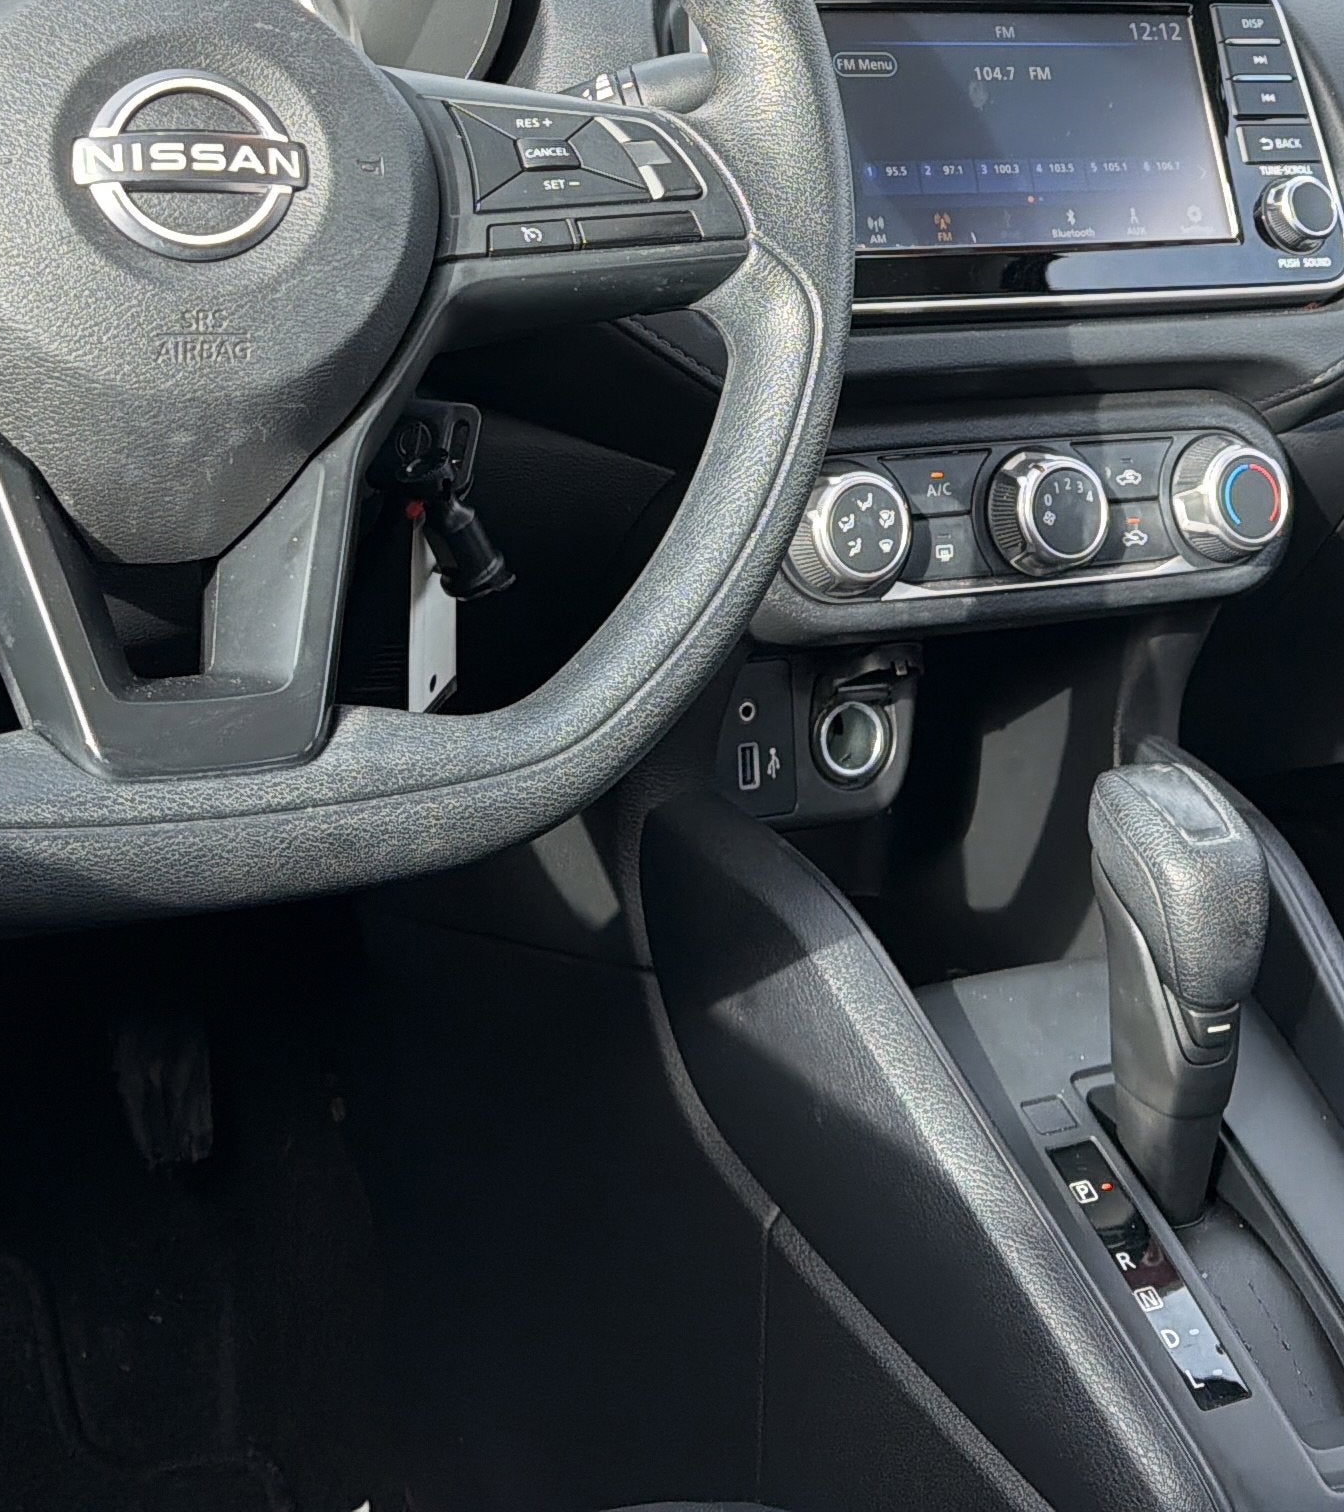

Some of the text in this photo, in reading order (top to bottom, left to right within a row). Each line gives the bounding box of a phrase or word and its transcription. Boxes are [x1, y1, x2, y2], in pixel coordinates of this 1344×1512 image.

[1241, 18, 1264, 29] DISP
[995, 26, 1015, 39] FM
[1128, 22, 1182, 41] 12:12
[836, 58, 893, 71] FM Menu
[974, 67, 1052, 81] 104.7 FM
[515, 118, 539, 129] RES
[1275, 138, 1302, 149] BACK
[524, 146, 570, 159] CANCEL
[86, 142, 301, 179] NISSAN
[885, 166, 907, 177] 95.5
[924, 166, 931, 176] 2
[942, 165, 964, 176] 97.1
[981, 164, 988, 175] 3
[993, 164, 1020, 175] 100.3
[1036, 162, 1043, 173] 4
[1048, 163, 1075, 173] 103.5
[1103, 162, 1128, 172] 105.1
[543, 179, 565, 191] SET
[869, 233, 887, 244] AM
[937, 231, 953, 242] FM
[1051, 227, 1096, 239] Bluetooth
[1277, 258, 1332, 269] PUSH SOUND
[180, 308, 229, 331] SRS
[157, 341, 252, 365] AIRBAG
[926, 481, 952, 498] A/C
[1054, 481, 1060, 494] 1
[1064, 477, 1071, 491] 2
[1077, 480, 1084, 494] 3
[1044, 493, 1053, 506] 0
[1086, 489, 1094, 503] 4
[1115, 1252, 1136, 1271] R
[1140, 1291, 1157, 1309] N
[1160, 1329, 1180, 1349] D
[1185, 1369, 1205, 1389] L
